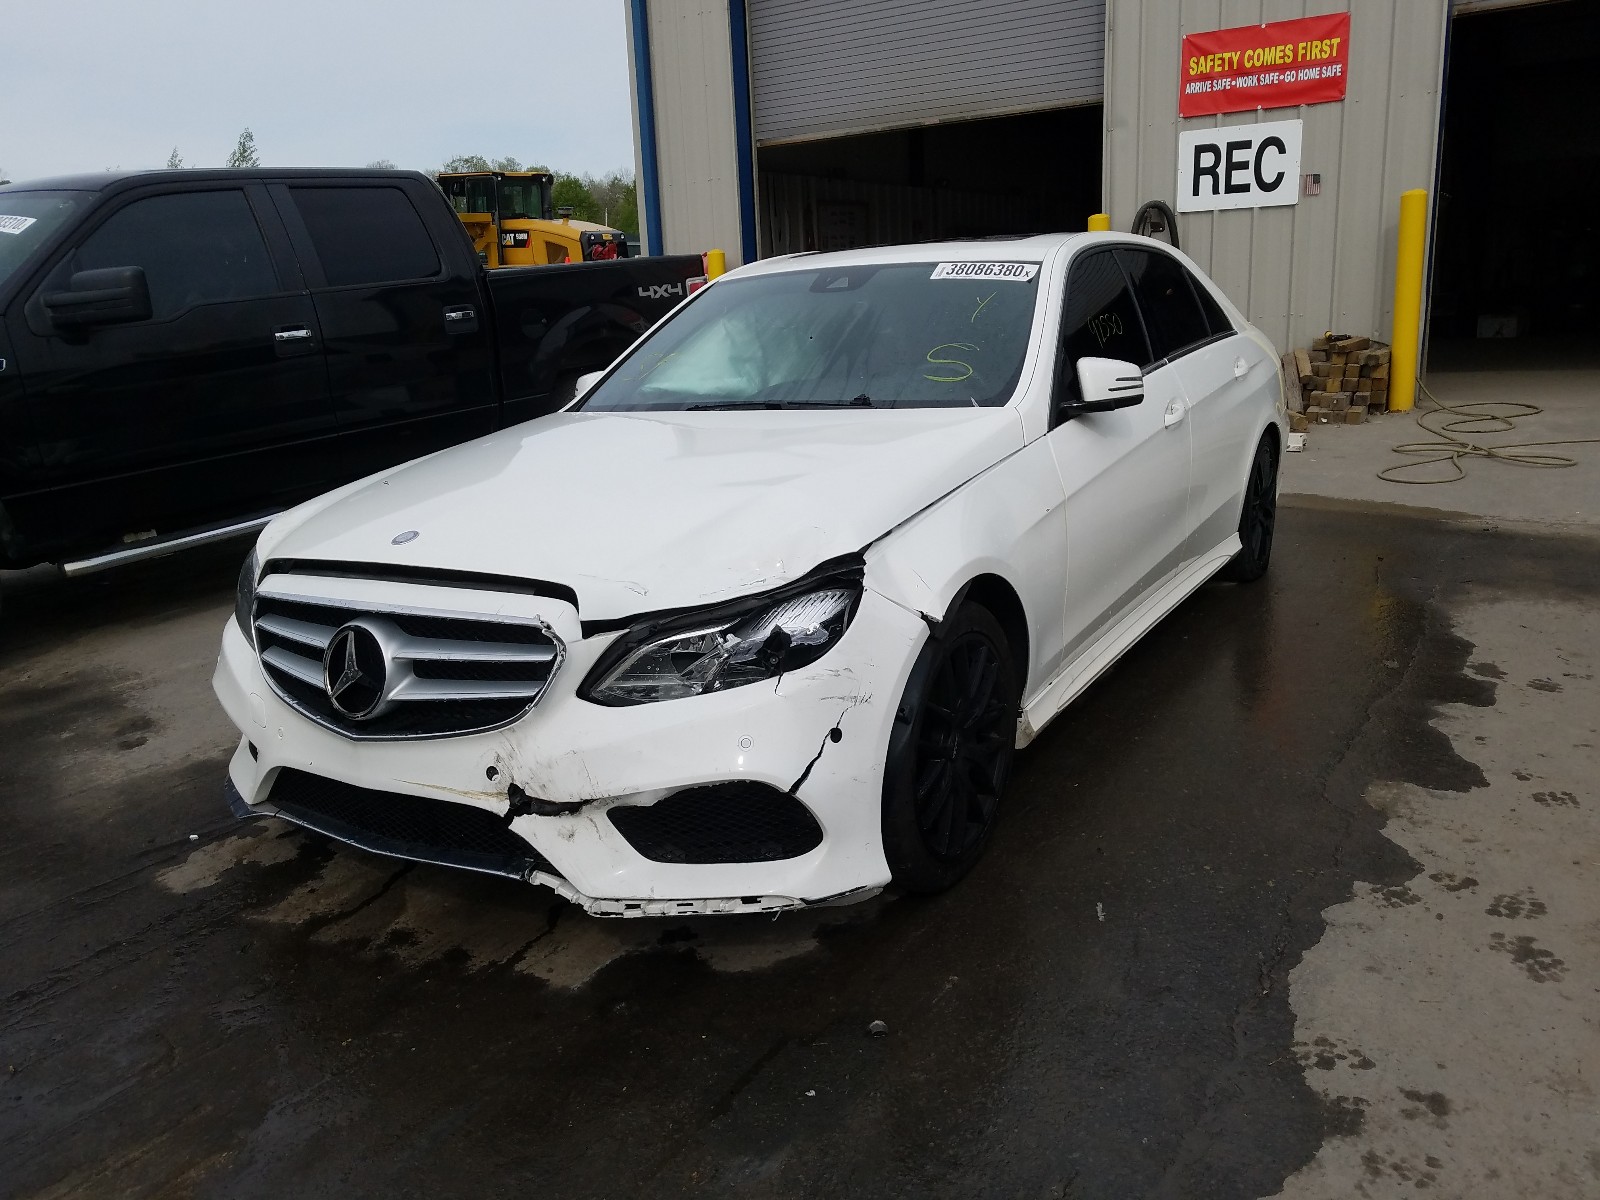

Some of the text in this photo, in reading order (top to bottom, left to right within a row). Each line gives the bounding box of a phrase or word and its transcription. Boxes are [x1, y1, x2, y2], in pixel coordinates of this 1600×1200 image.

[1189, 37, 1341, 76] SAFETY COMES FIRST
[1185, 64, 1343, 95] ARRIVE SAFE WORK SAFE GO HOME SAFE
[1192, 135, 1287, 197] REC
[501, 233, 515, 246] CAT
[945, 263, 1025, 277] 38086380
